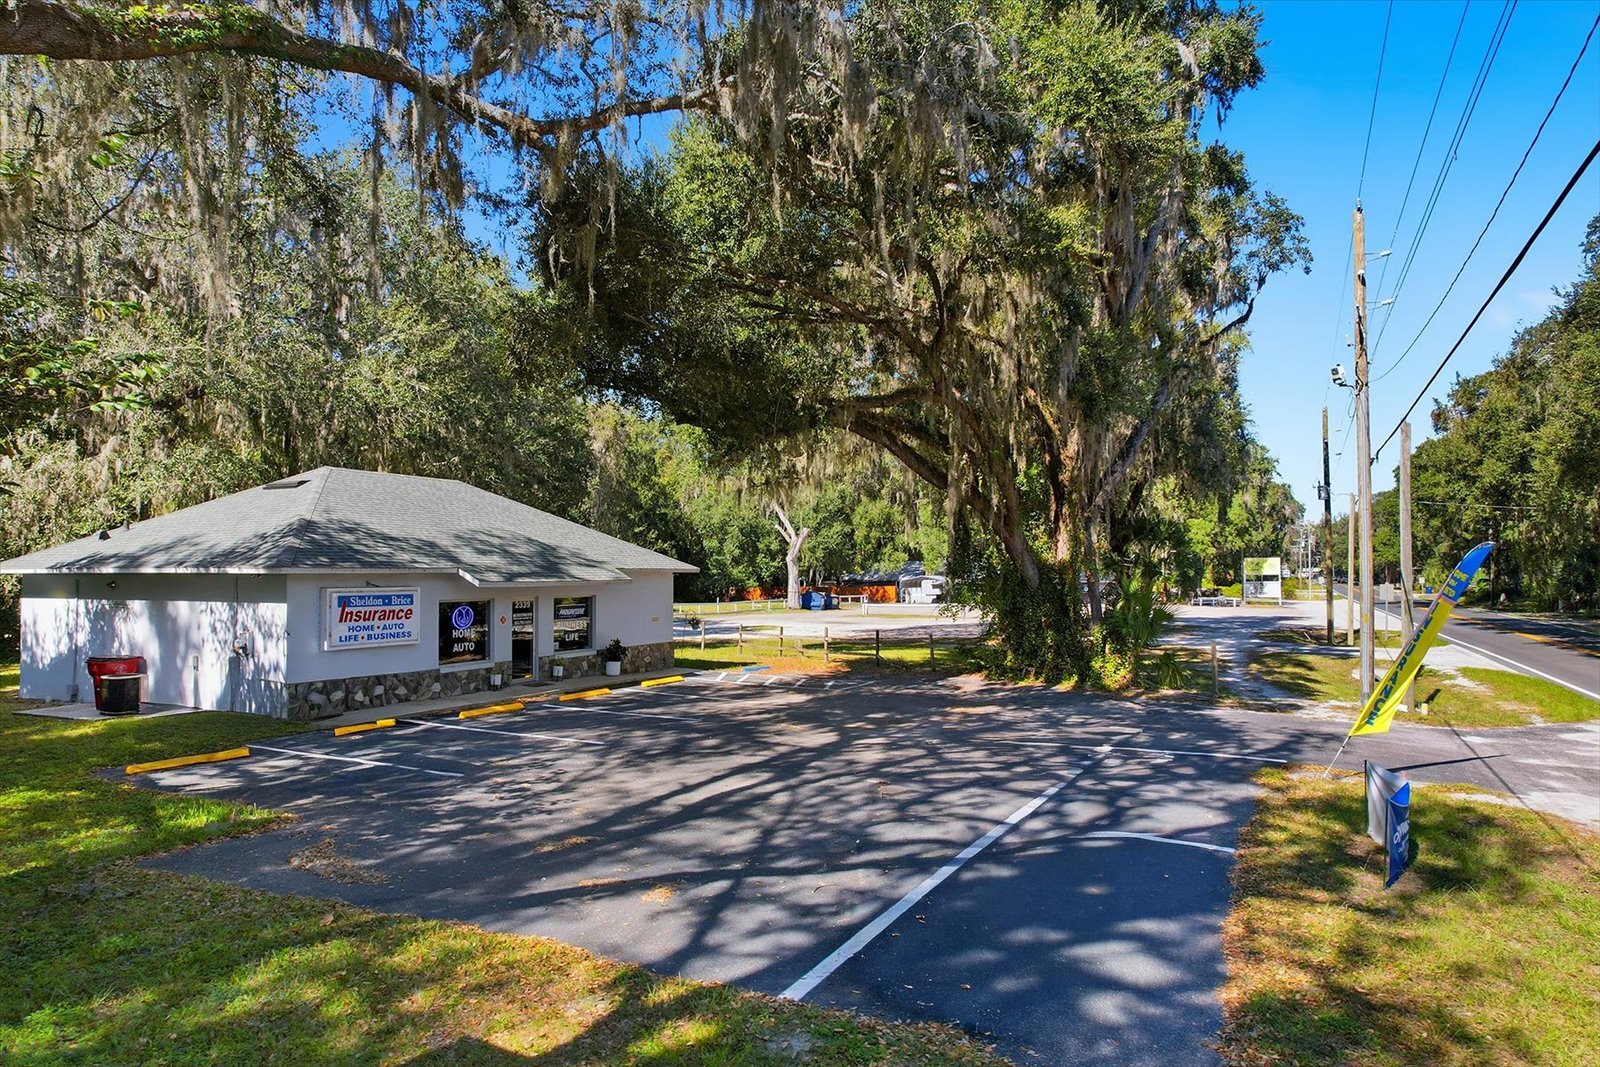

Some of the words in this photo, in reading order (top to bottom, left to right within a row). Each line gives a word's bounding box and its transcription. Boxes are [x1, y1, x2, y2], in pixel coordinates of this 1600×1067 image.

[350, 596, 382, 606] Sheldon
[391, 596, 411, 605] Brice
[338, 600, 413, 623] Insurance
[381, 623, 404, 631] AUTO
[367, 631, 412, 640] BUSINESS
[452, 628, 475, 638] HOME
[565, 633, 579, 641] LIFE
[452, 642, 475, 652] AUTO
[1366, 602, 1440, 727] INSURANCE
